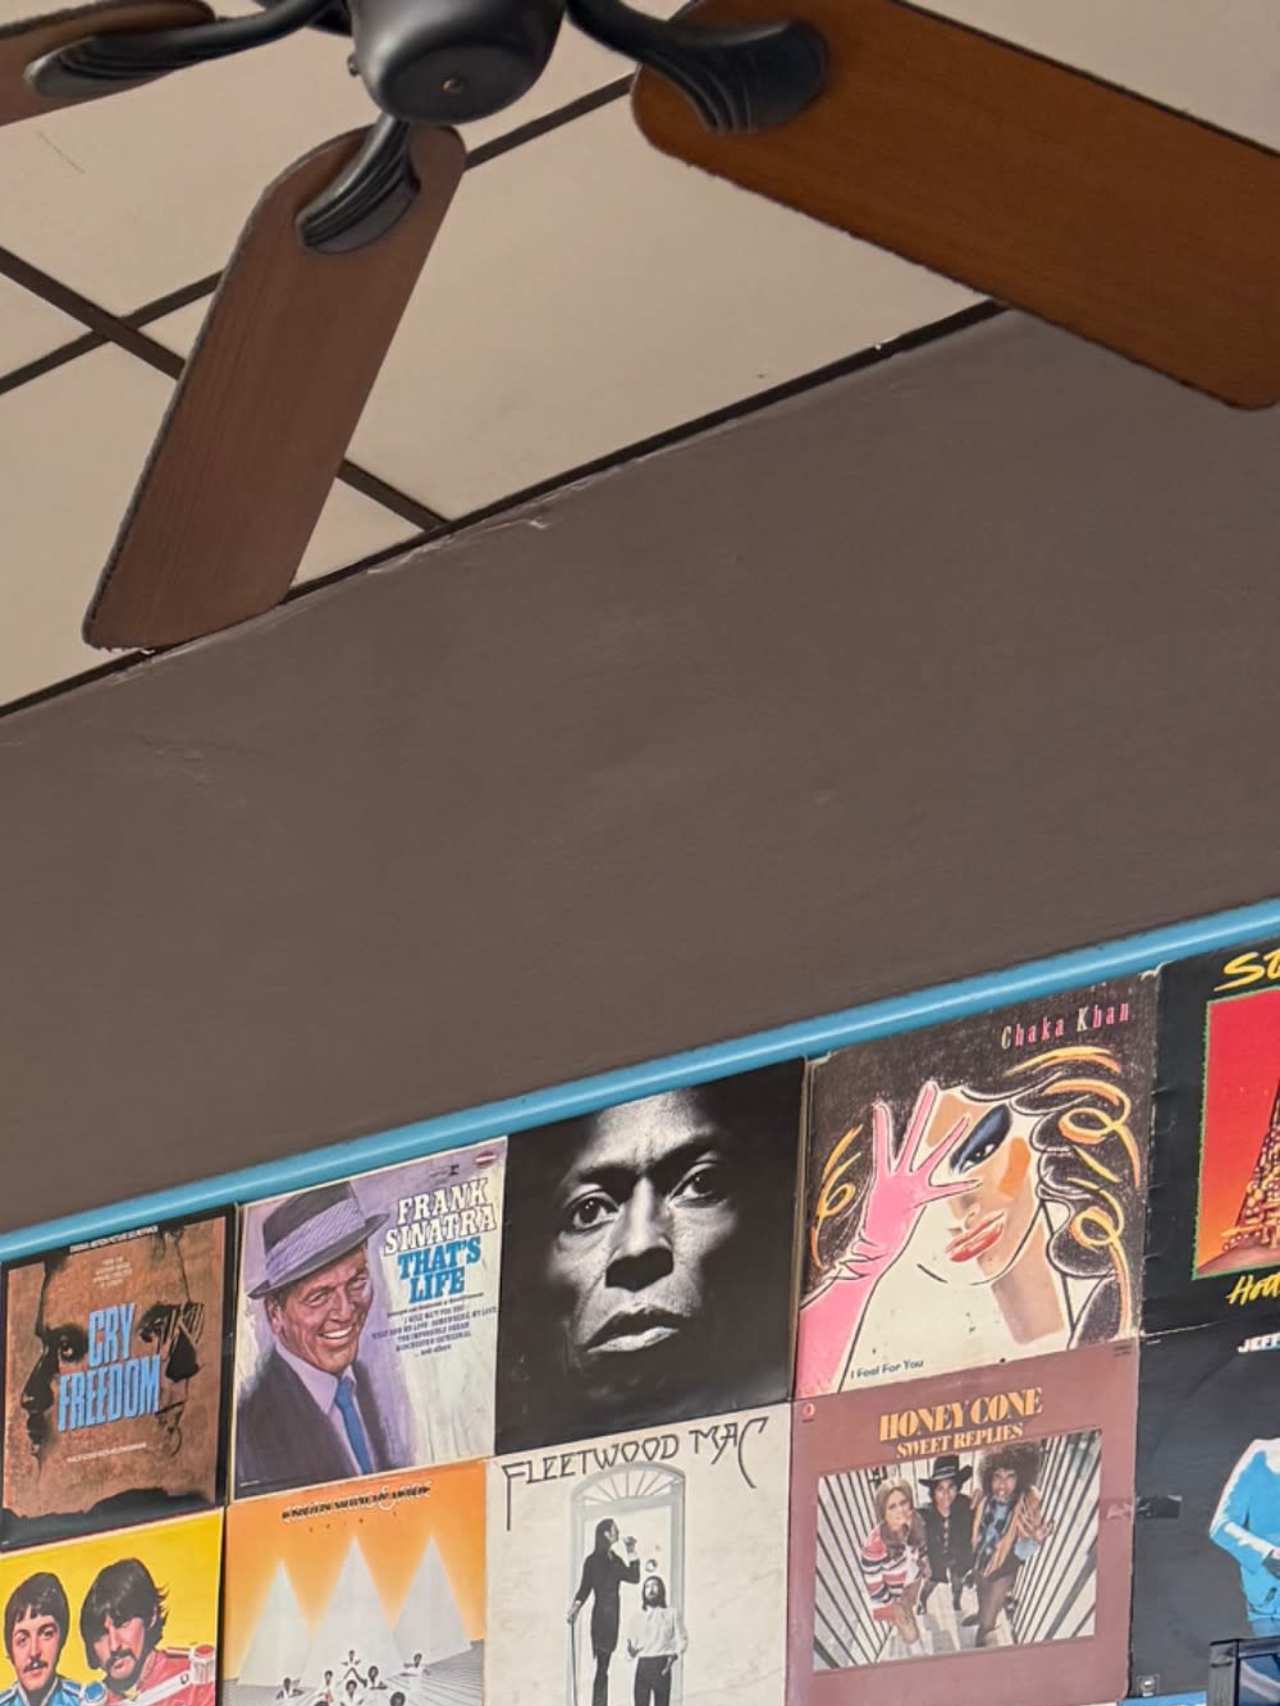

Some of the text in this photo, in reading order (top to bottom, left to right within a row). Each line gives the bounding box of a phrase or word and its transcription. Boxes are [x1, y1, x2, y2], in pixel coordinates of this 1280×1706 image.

[1000, 1000, 1131, 1050] Chaka Khan
[397, 1177, 489, 1226] FRANK
[383, 1203, 498, 1257] SINATRA
[397, 1235, 481, 1280] THAT'S
[408, 1265, 465, 1304] LIFE
[87, 1302, 136, 1369] CRY
[881, 1362, 901, 1376] For
[901, 1357, 925, 1372] You
[57, 1354, 161, 1433] FREEDOM
[879, 1386, 1043, 1441] HONEY CONE
[896, 1422, 1024, 1459] SWEET REPLIES
[502, 1435, 680, 1532] FLEETWOOD
[689, 1417, 769, 1490] MAC
